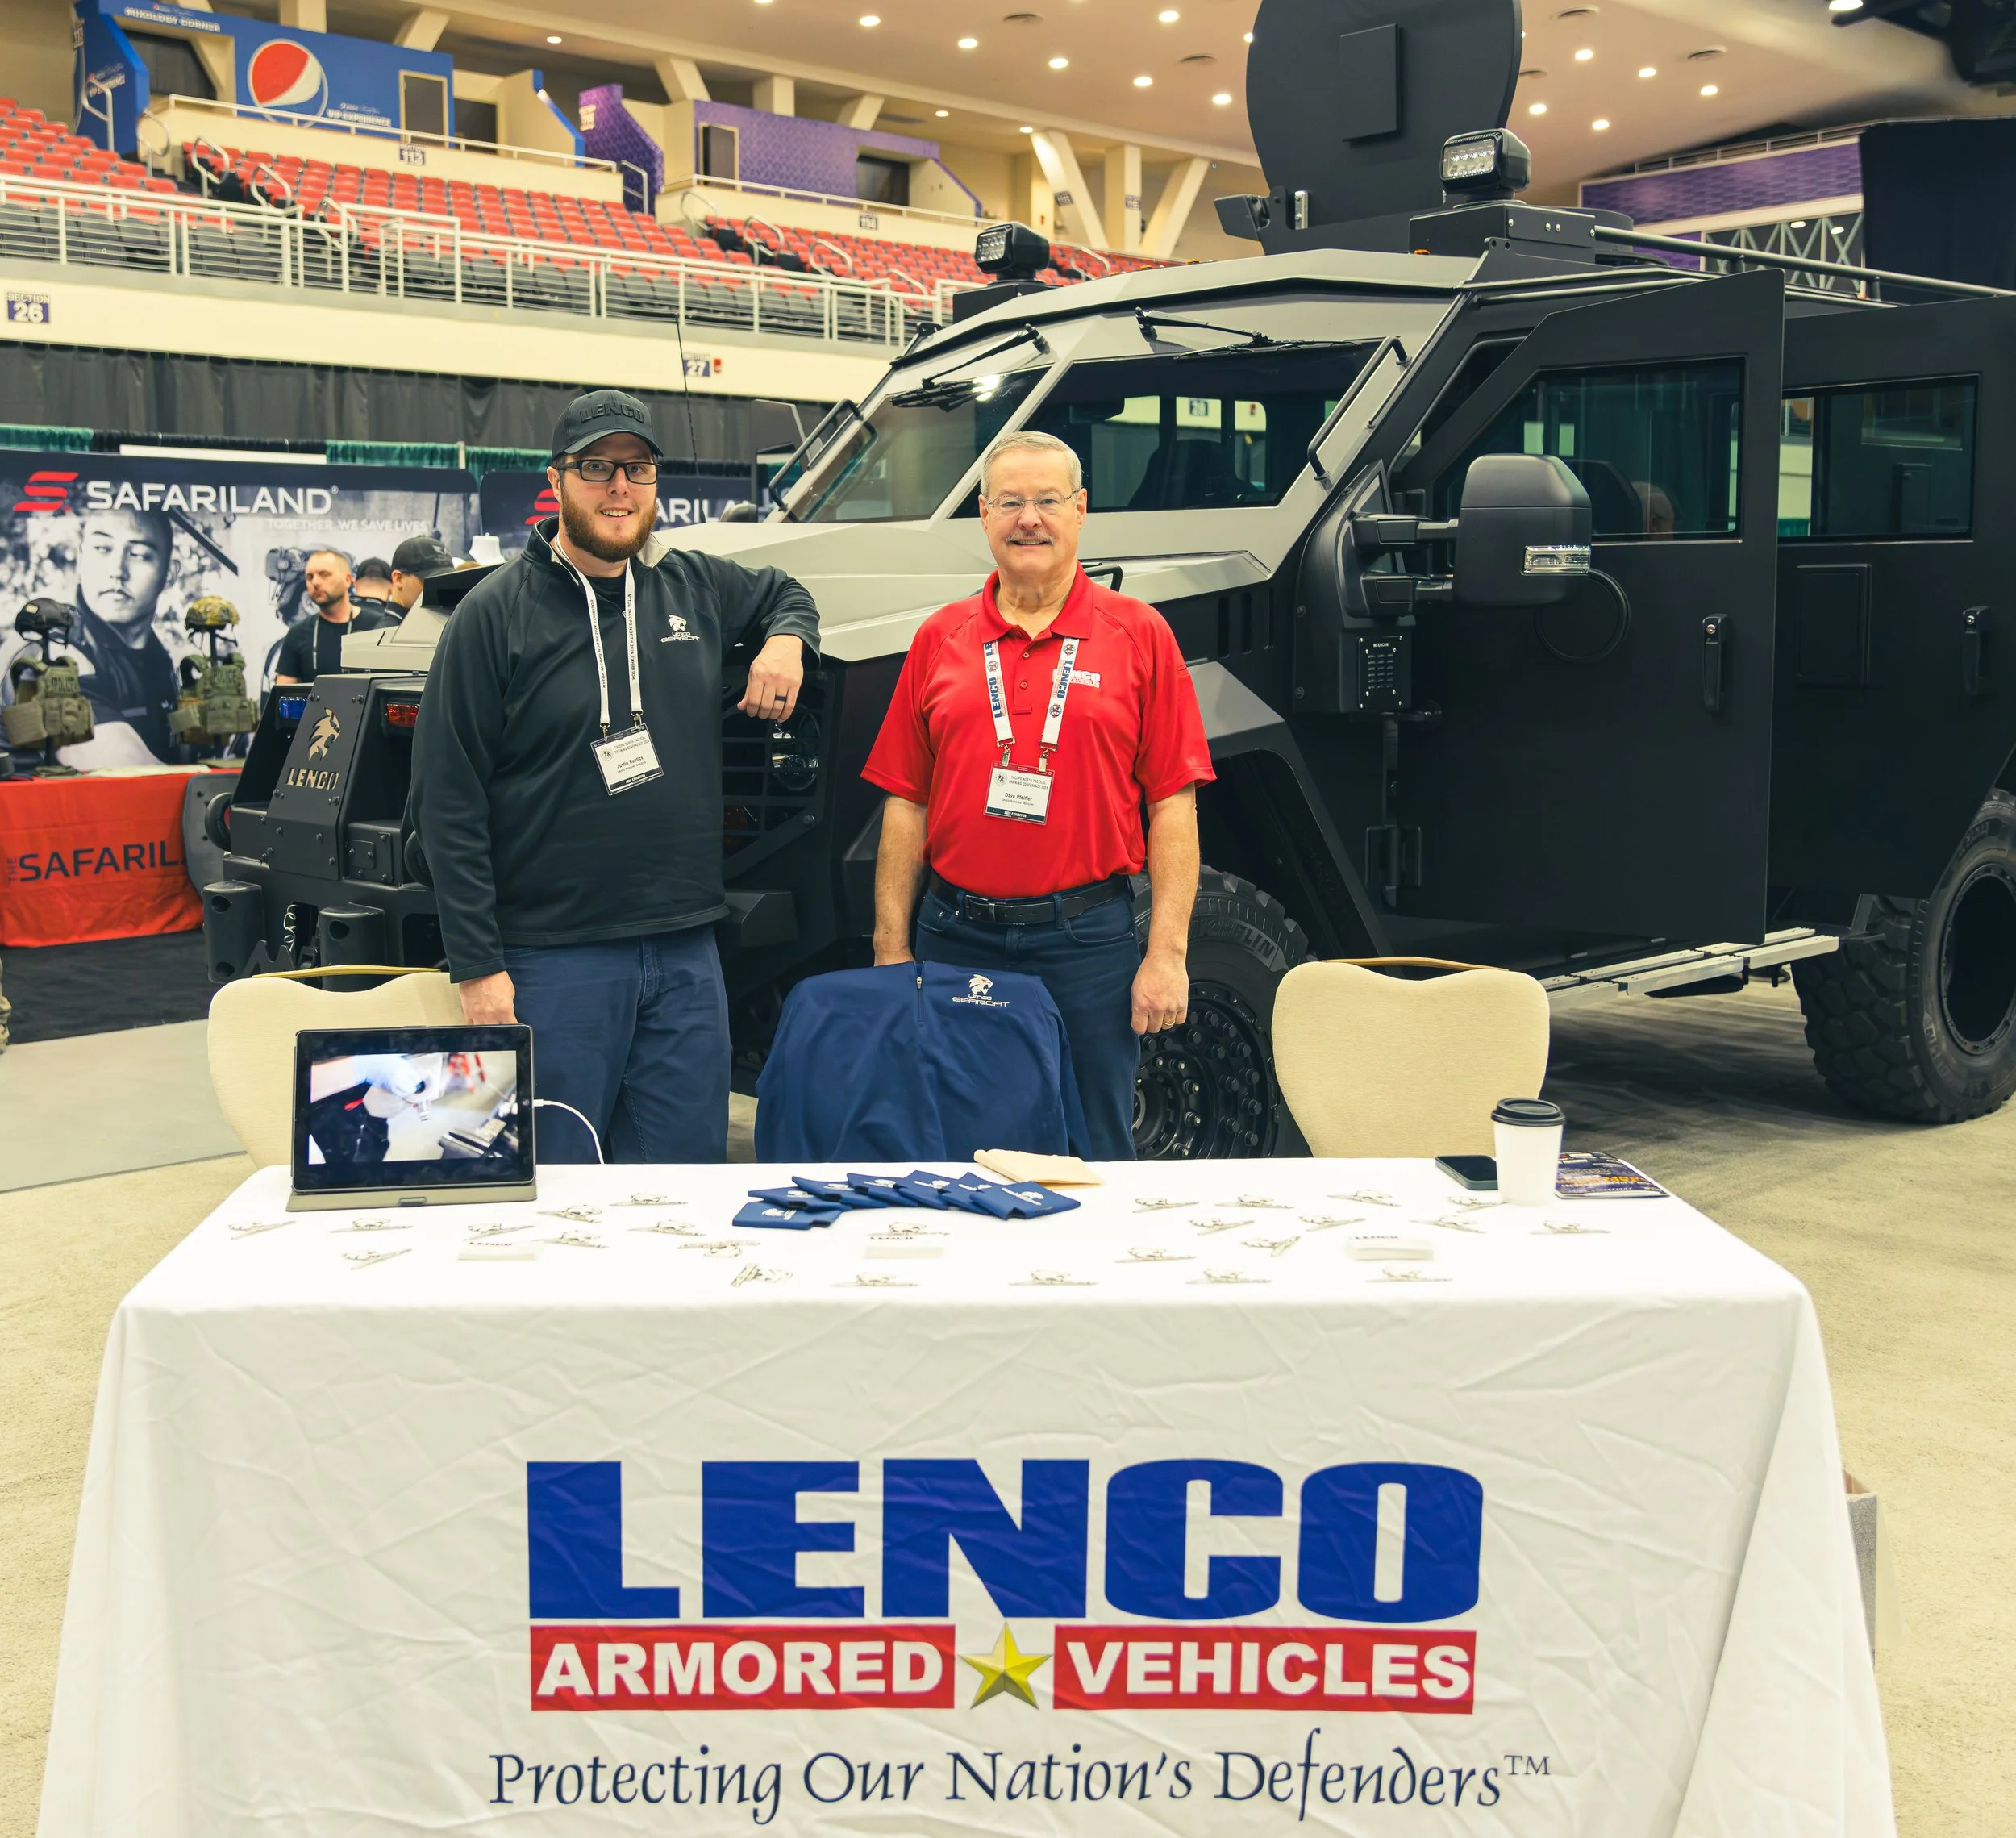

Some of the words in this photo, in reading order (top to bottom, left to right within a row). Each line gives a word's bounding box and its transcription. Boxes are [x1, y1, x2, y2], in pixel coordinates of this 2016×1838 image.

[13, 302, 44, 323] 26
[687, 360, 706, 377] 27
[580, 403, 644, 423] LENCO
[338, 519, 360, 531] WE
[361, 520, 394, 532] SAVE
[1057, 660, 1073, 698] LENCO
[989, 677, 1002, 718] LENCO
[285, 768, 339, 790] LENCO
[6, 856, 19, 883] THE
[952, 996, 1010, 1007] BEARCAT
[527, 1458, 1483, 1623] LENCO
[537, 1640, 943, 1695] ARMORED
[1067, 1642, 1470, 1699] VEHICLES
[489, 1744, 781, 1826] Protecting
[803, 1752, 924, 1803] Our
[946, 1743, 1193, 1803] Nation's
